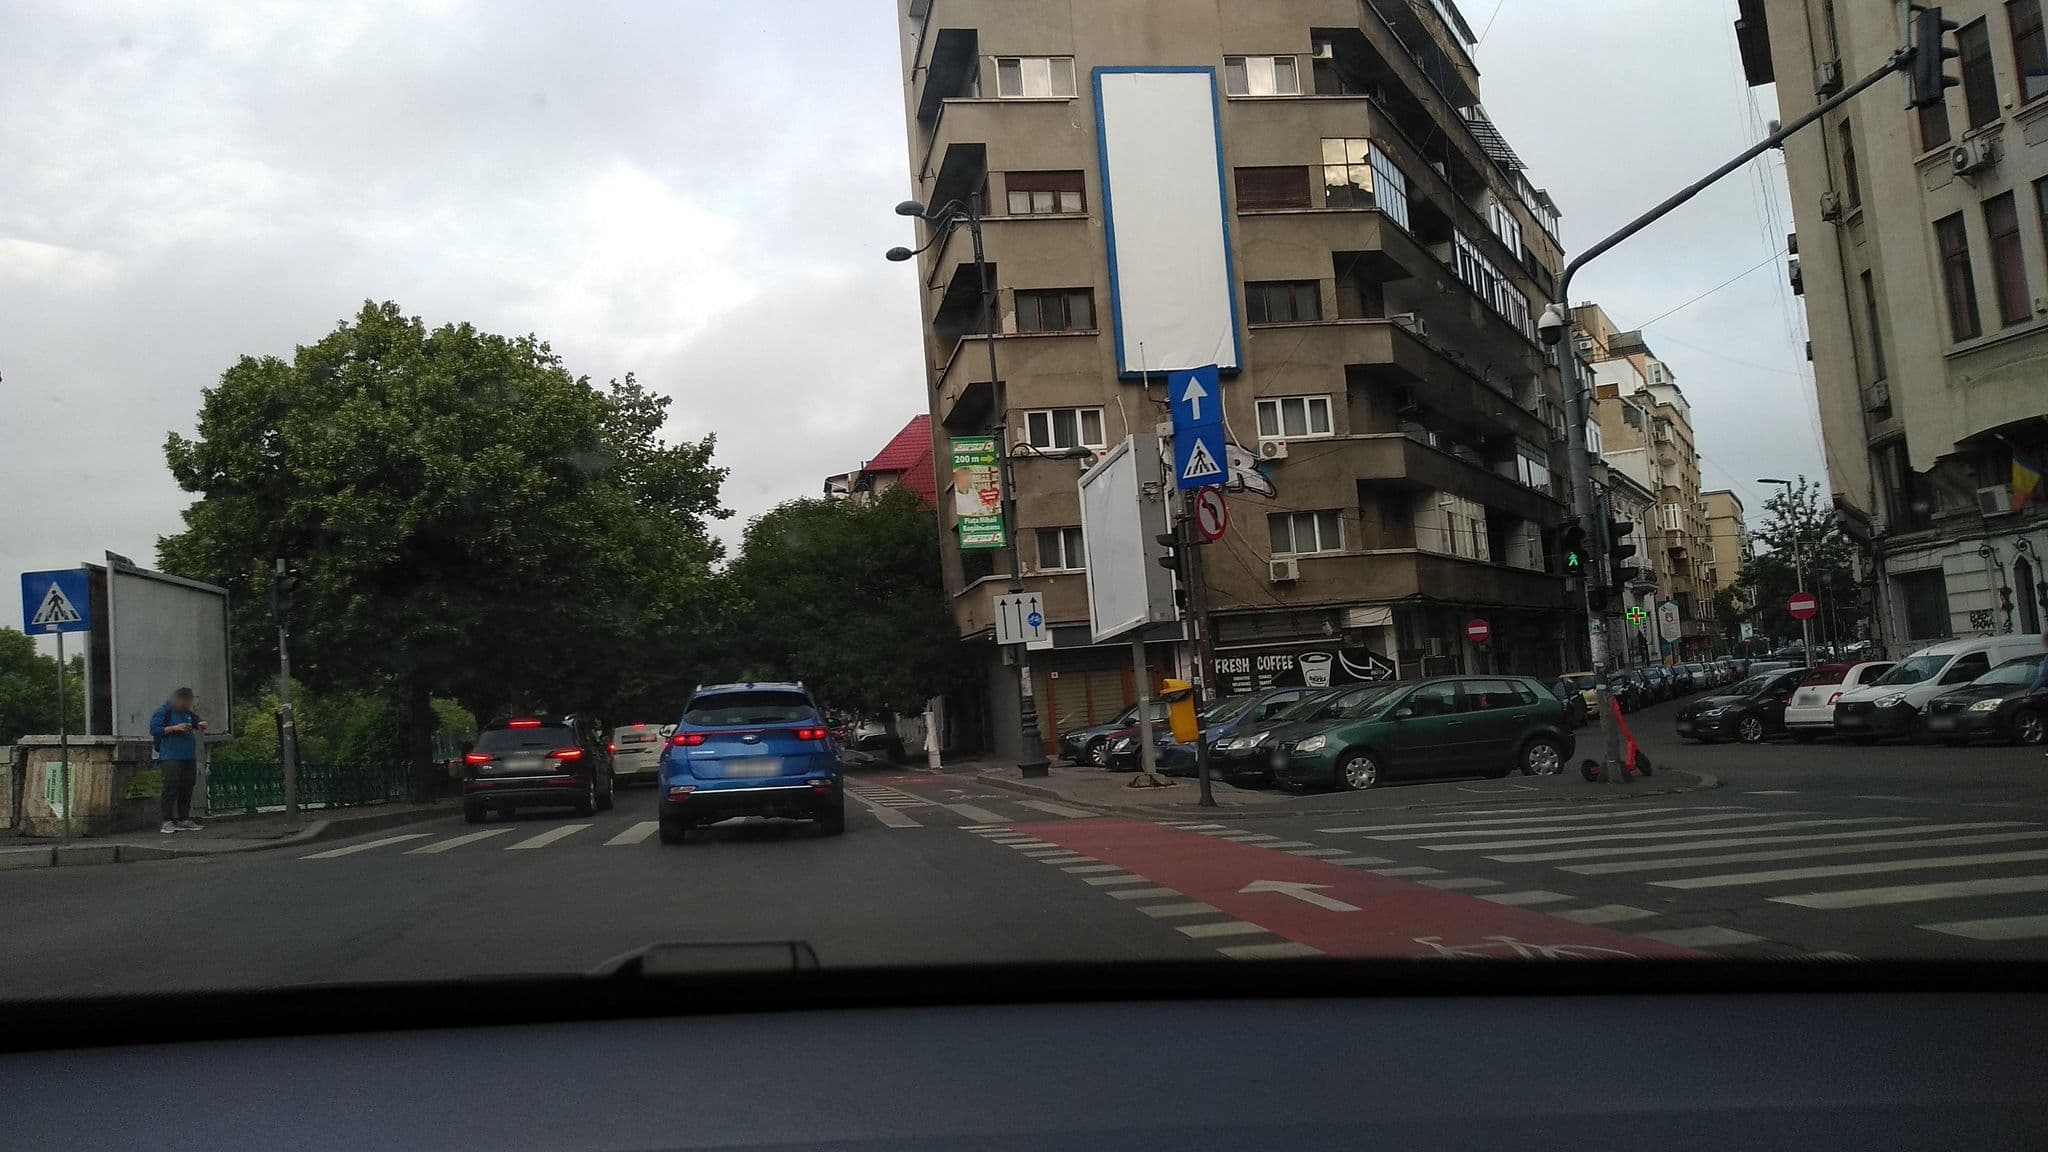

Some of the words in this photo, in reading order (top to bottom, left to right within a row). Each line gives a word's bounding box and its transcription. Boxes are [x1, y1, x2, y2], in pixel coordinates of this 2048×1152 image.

[954, 455, 970, 463] 200
[1215, 657, 1250, 674] FRESH
[1257, 655, 1294, 671] COFFEE
